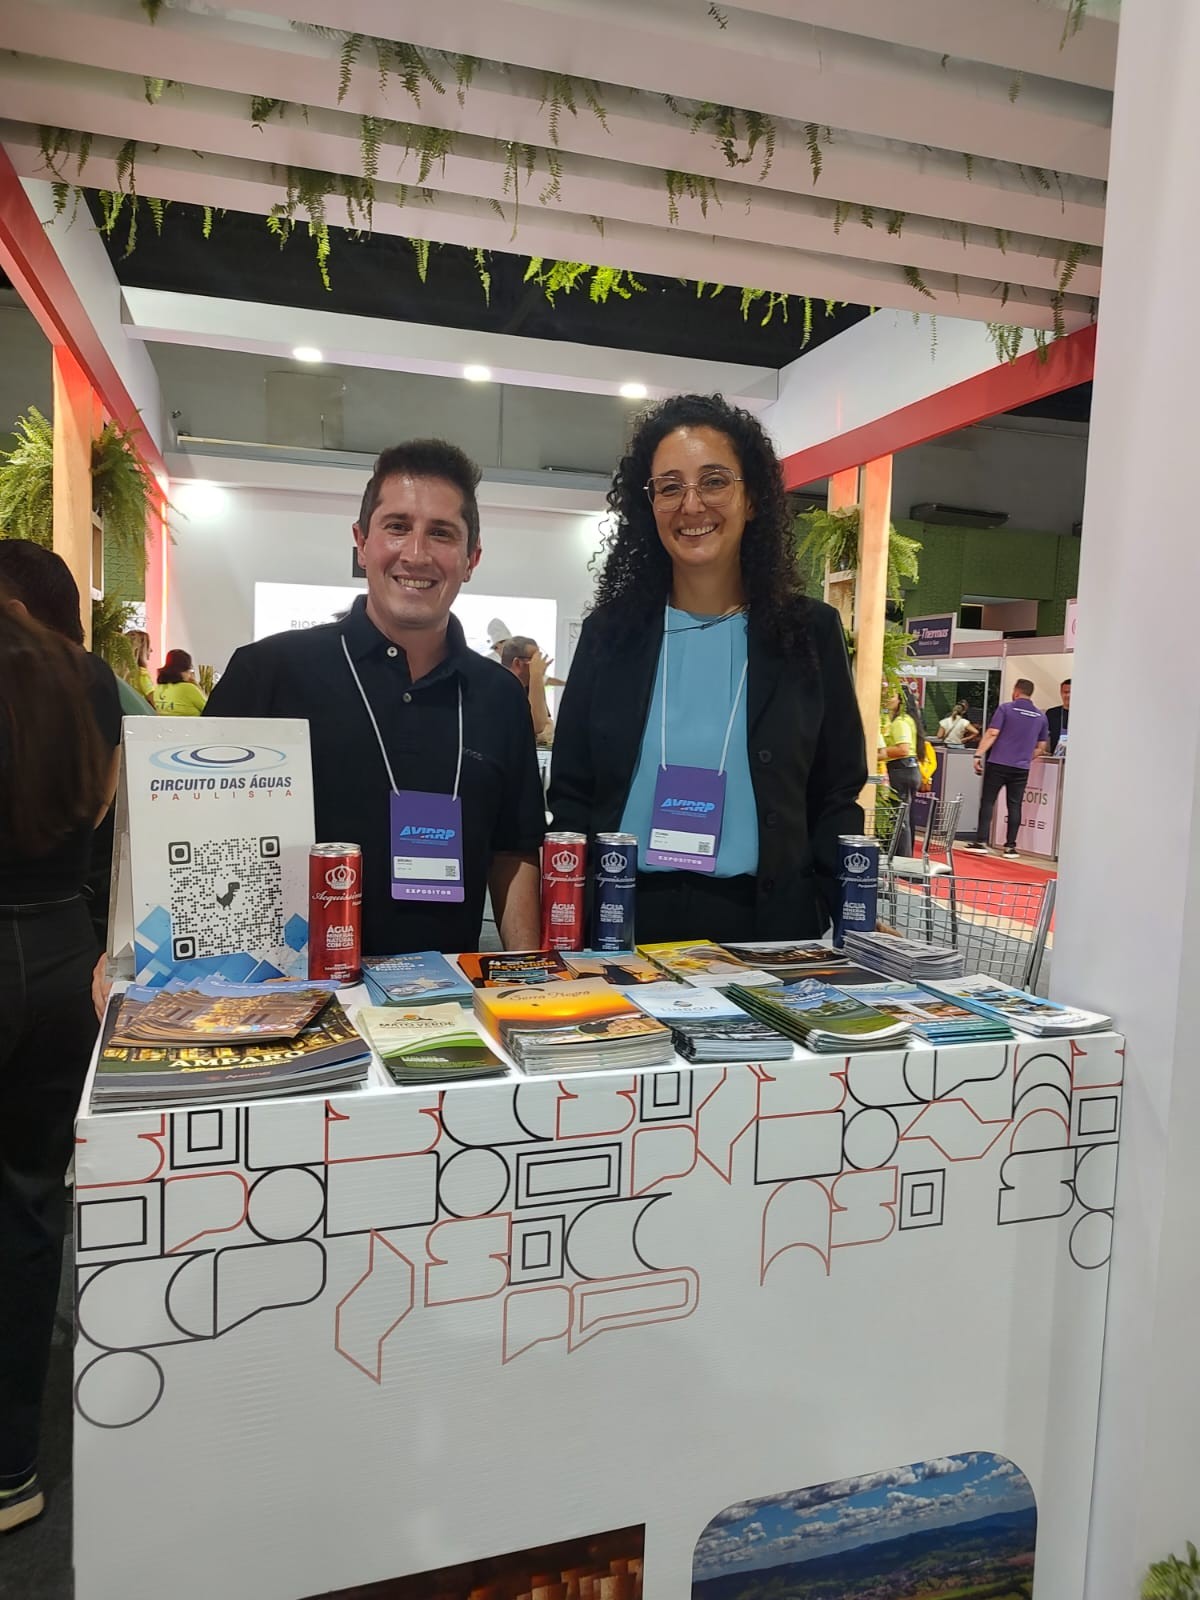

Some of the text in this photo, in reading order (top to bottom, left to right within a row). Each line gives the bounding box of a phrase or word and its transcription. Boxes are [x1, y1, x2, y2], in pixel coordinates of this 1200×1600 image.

[150, 774, 292, 791] CIRCUITO DAS ÁGUAS
[151, 789, 292, 801] PAULISTA
[658, 855, 702, 865] EXPOSITOR
[405, 888, 451, 896] EXPOSITOR
[327, 925, 354, 934] ÁGUA
[168, 1050, 305, 1068] AMPARO
